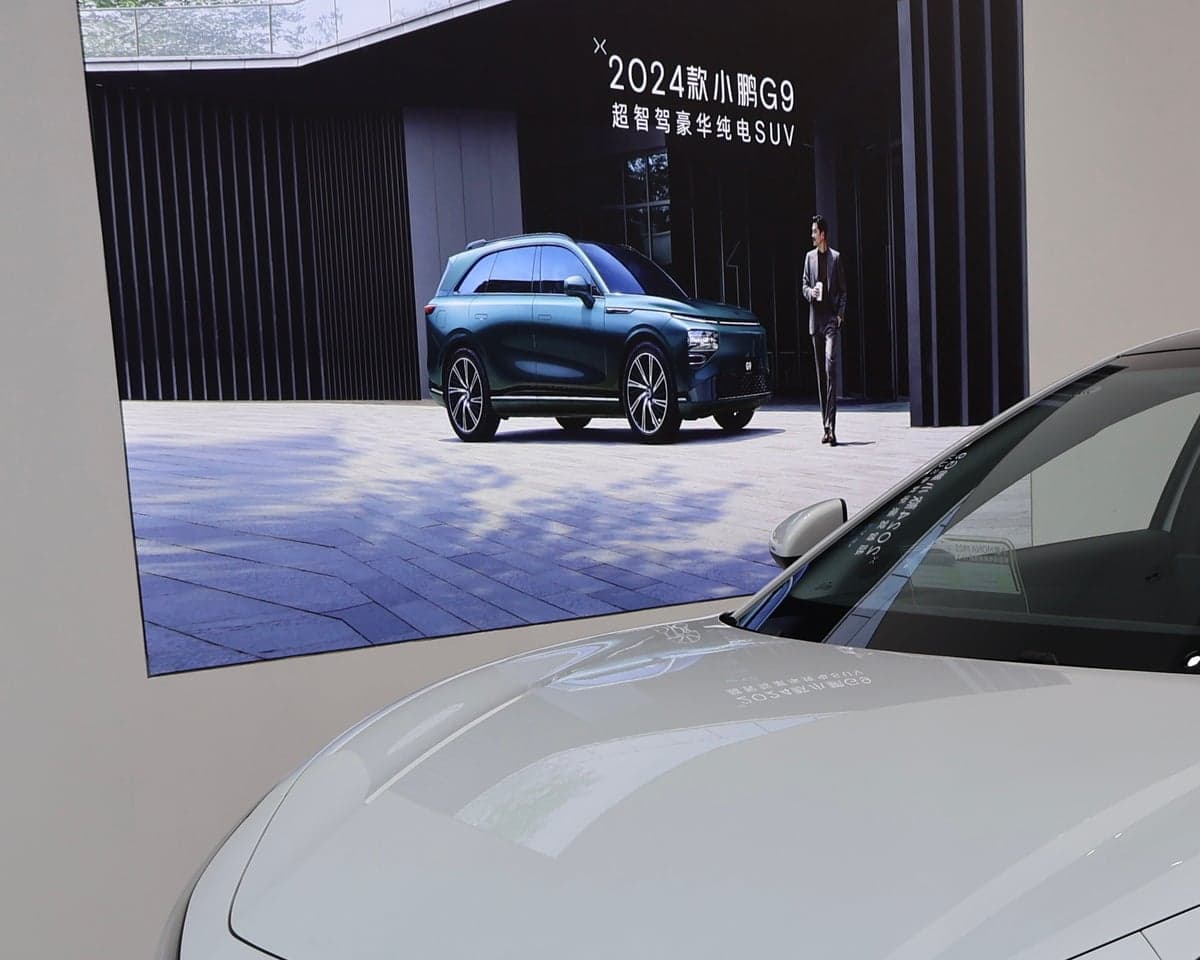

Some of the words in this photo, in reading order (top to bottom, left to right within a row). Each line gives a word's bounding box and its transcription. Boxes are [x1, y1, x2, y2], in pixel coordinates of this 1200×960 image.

[608, 54, 795, 112] 2024款小鹏G9
[611, 101, 795, 147] 超智驾豪华纯电SUV
